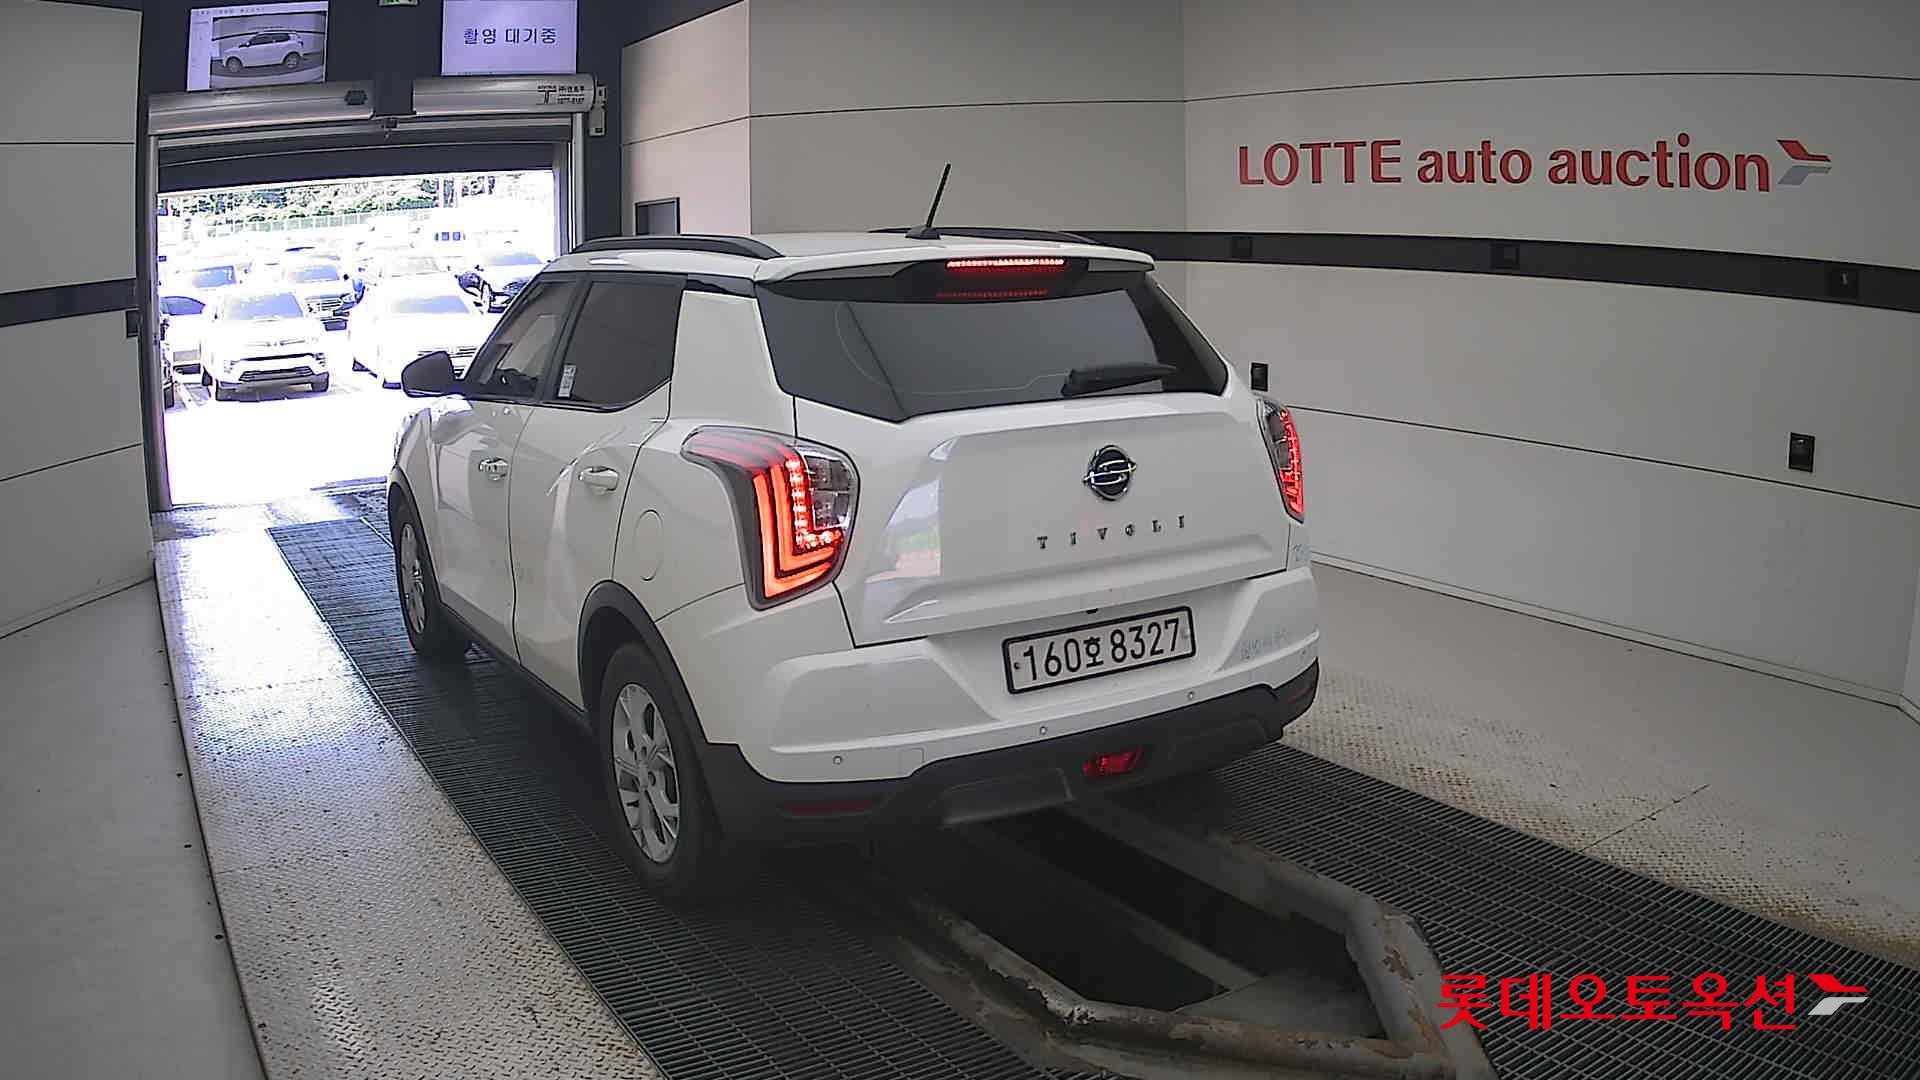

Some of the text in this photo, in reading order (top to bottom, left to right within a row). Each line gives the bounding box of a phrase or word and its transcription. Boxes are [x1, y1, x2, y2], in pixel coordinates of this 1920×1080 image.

[464, 27, 557, 45] 촬영 대기중
[1239, 133, 1770, 192] LOTTE auto auction
[1036, 515, 1185, 549] TIVOLI
[1023, 636, 1104, 681] 160호
[1110, 618, 1180, 663] 8327
